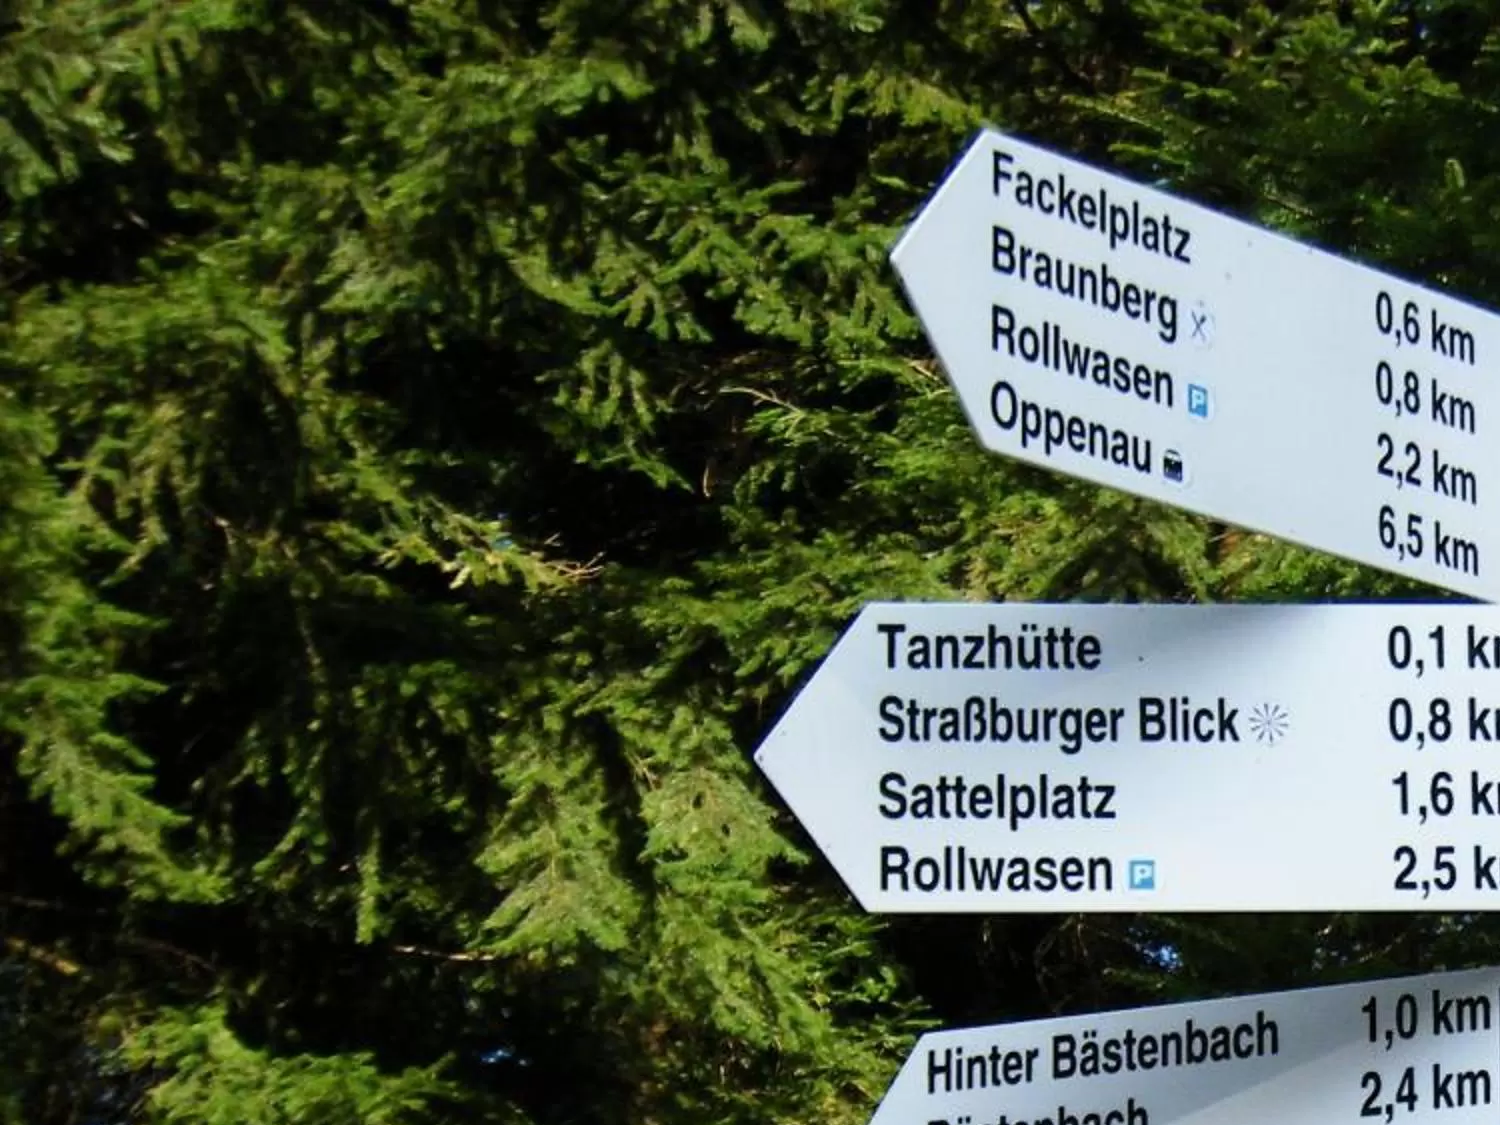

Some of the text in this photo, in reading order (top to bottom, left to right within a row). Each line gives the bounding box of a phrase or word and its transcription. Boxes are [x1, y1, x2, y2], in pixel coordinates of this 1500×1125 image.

[993, 151, 1475, 365] Fackelplatz 0,6 km
[992, 225, 1475, 434] Braunberg 0,8 km
[992, 304, 1173, 408] Rollwasen
[1377, 432, 1421, 489] 2,2
[1433, 449, 1476, 505] km
[991, 381, 1478, 576] Oppenau 6,5 km
[878, 624, 1102, 670] Tanzhütte
[1388, 626, 1444, 677] 0,1
[879, 695, 1124, 754] Straßburger
[1140, 697, 1240, 742] Blick
[1389, 698, 1452, 750] 0,8
[879, 772, 1116, 831] Sattelplatz
[1392, 771, 1454, 824] 1,6
[881, 846, 1112, 891] Rollwasen
[1394, 845, 1456, 897] 2,5
[928, 990, 1491, 1094] Hinter Bästenbach 1,0 km
[1360, 1067, 1418, 1124] 2,4
[1433, 1064, 1491, 1109] km
